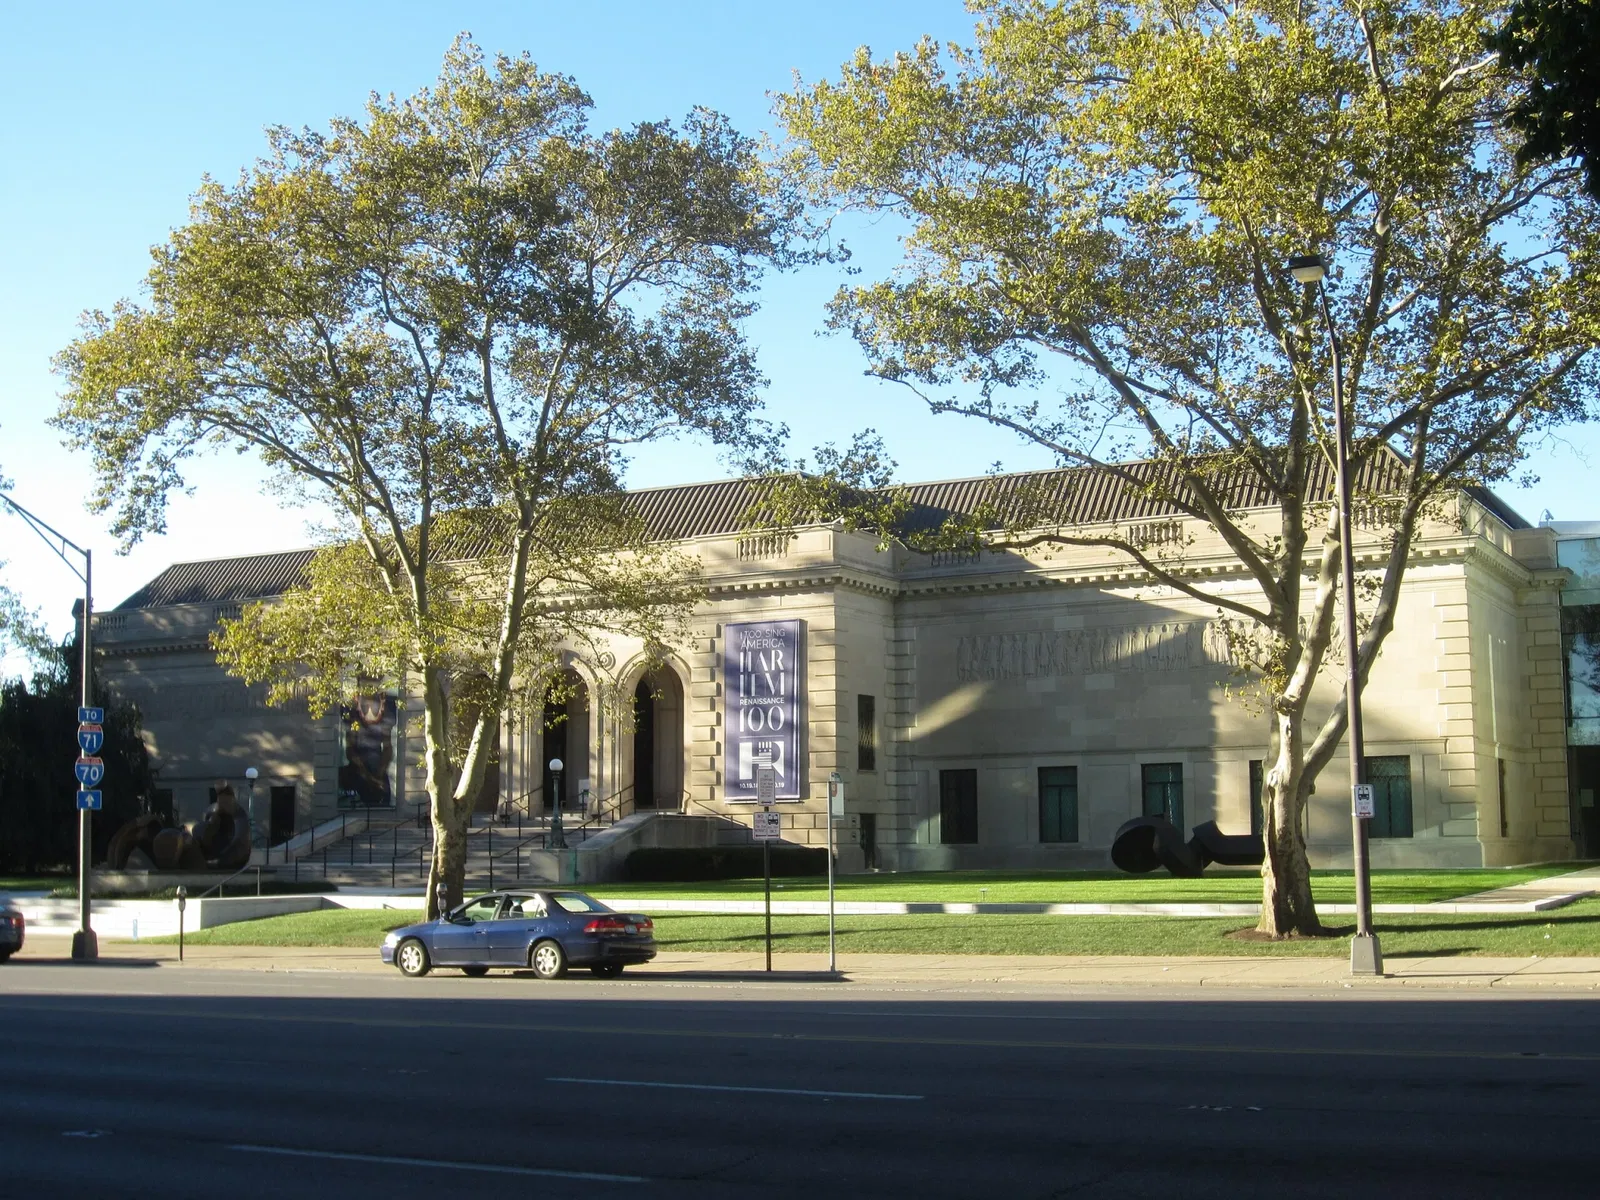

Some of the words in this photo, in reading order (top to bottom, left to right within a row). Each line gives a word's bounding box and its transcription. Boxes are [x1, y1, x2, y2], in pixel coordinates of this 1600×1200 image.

[744, 629, 761, 639] TOO
[765, 629, 785, 637] SING
[740, 638, 785, 650] AMERICA
[740, 697, 784, 705] RENAISSANCE
[85, 711, 97, 720] TO
[740, 705, 784, 732] 100
[83, 734, 97, 748] 71
[80, 766, 99, 780] 70
